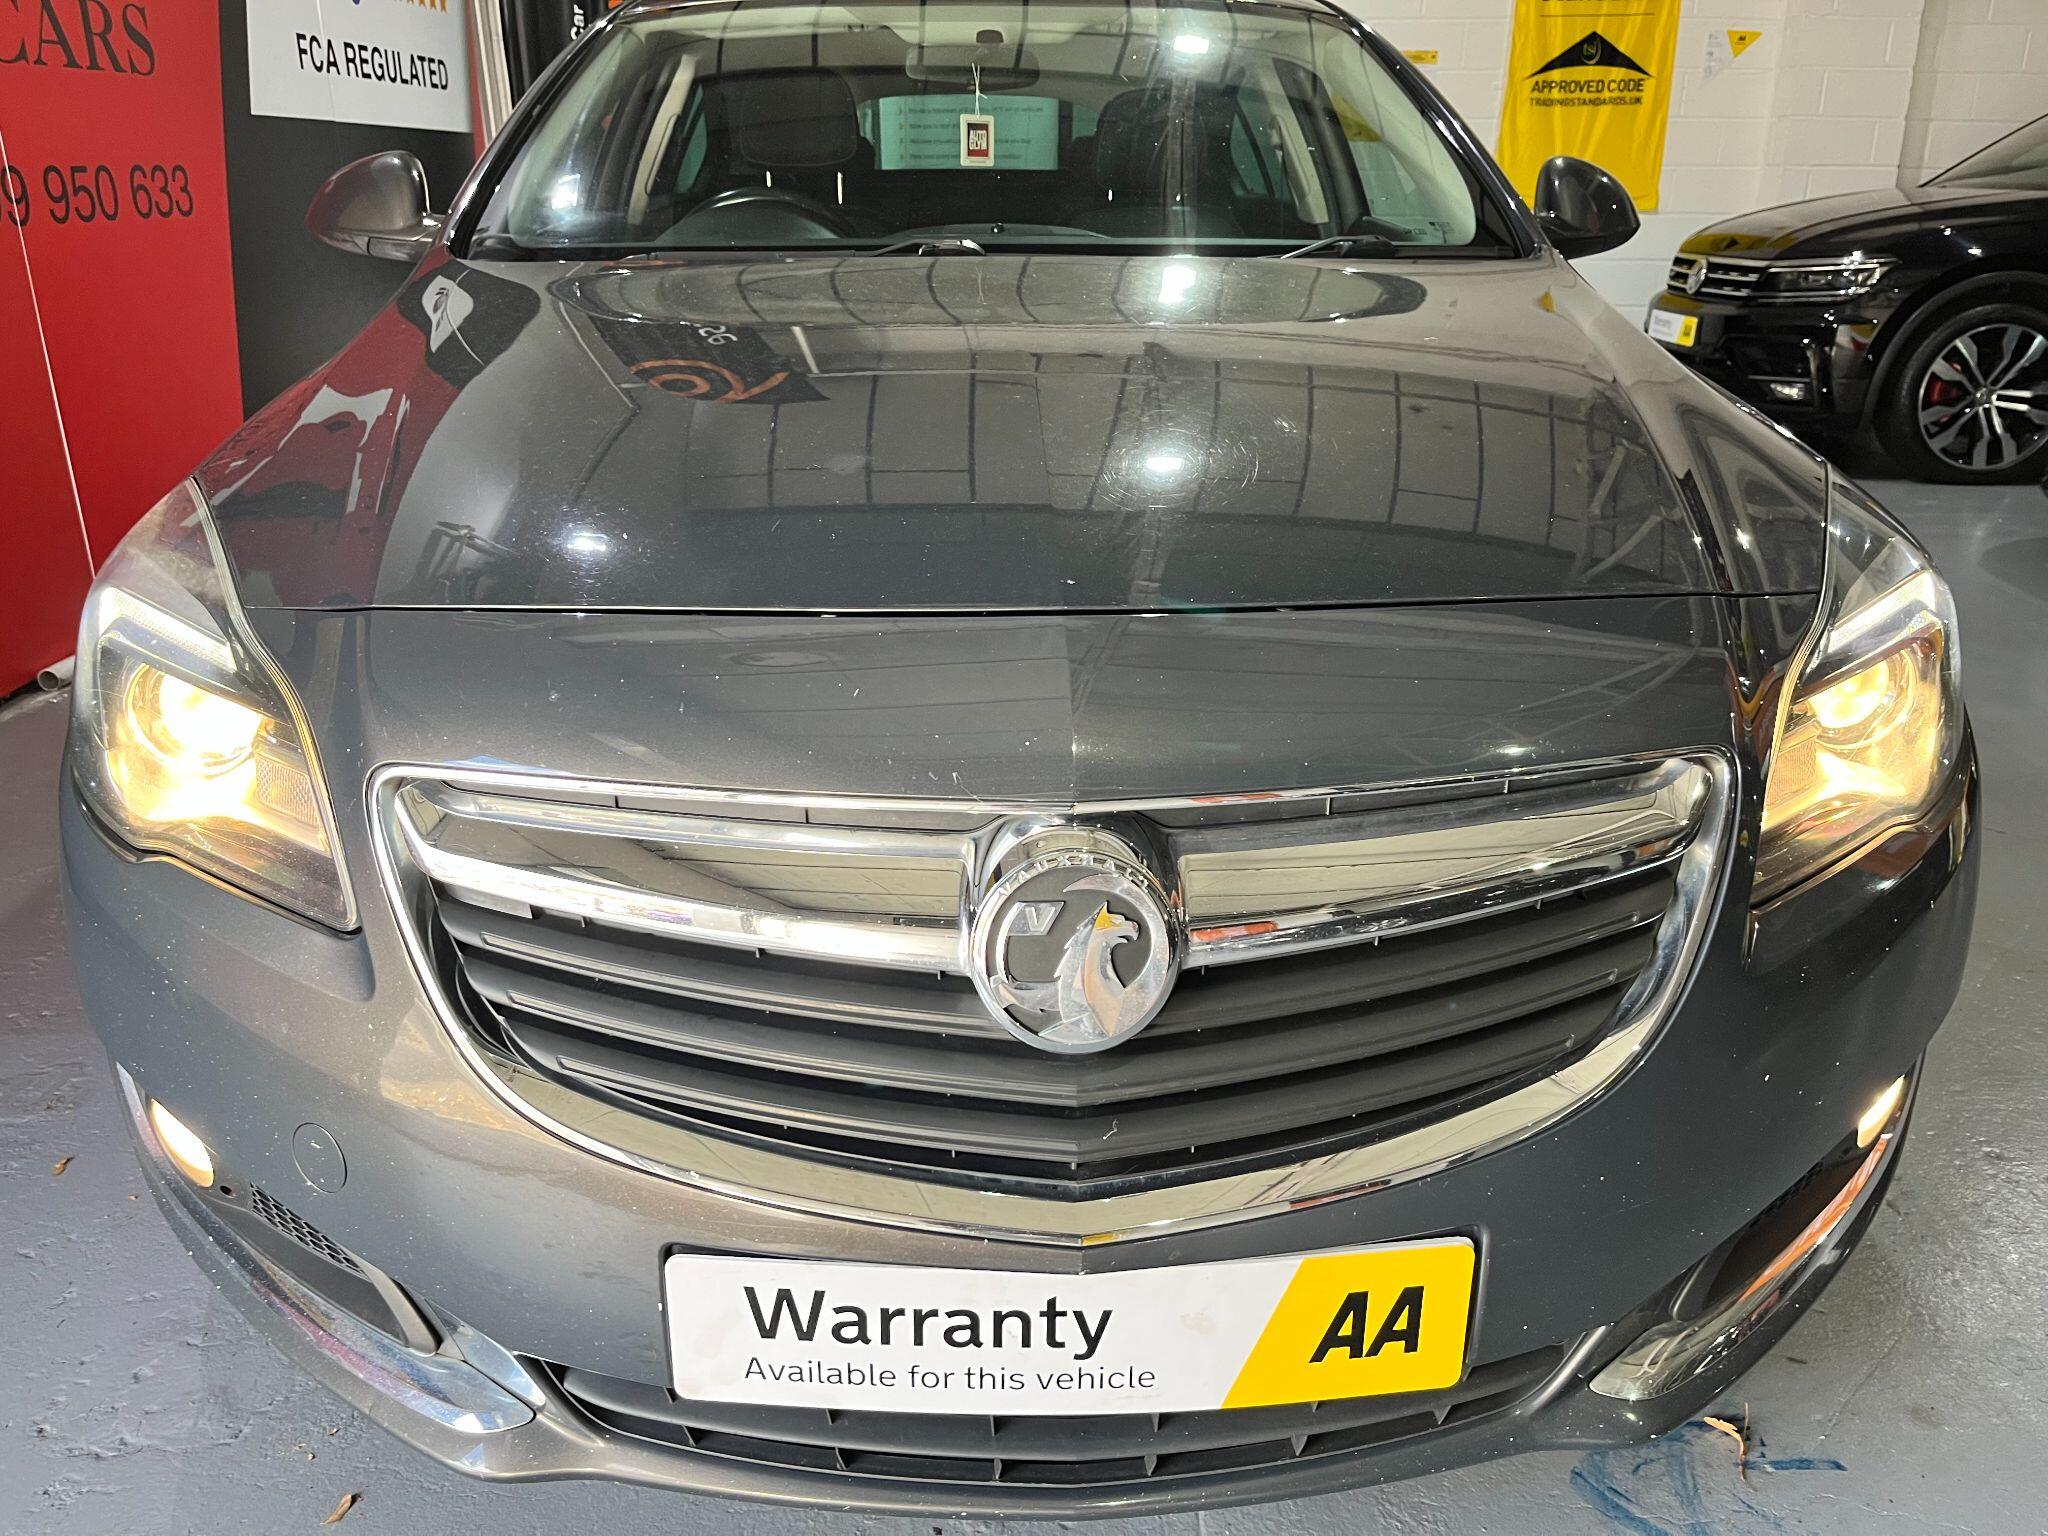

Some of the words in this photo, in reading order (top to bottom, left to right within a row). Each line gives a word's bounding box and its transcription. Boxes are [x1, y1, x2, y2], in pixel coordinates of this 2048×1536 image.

[570, 4, 585, 40] Car
[296, 33, 341, 76] FCA
[343, 41, 449, 90] REGULATED
[1531, 78, 1605, 95] APPROVED
[1607, 78, 1646, 94] CODE
[43, 164, 119, 225] 950
[130, 164, 194, 220] 633
[743, 1286, 1113, 1361] Warranty
[1308, 1285, 1425, 1364] AA
[744, 1356, 897, 1388] Available
[908, 1364, 955, 1390] for
[964, 1365, 1025, 1391] this
[1037, 1365, 1156, 1391] vehicle
